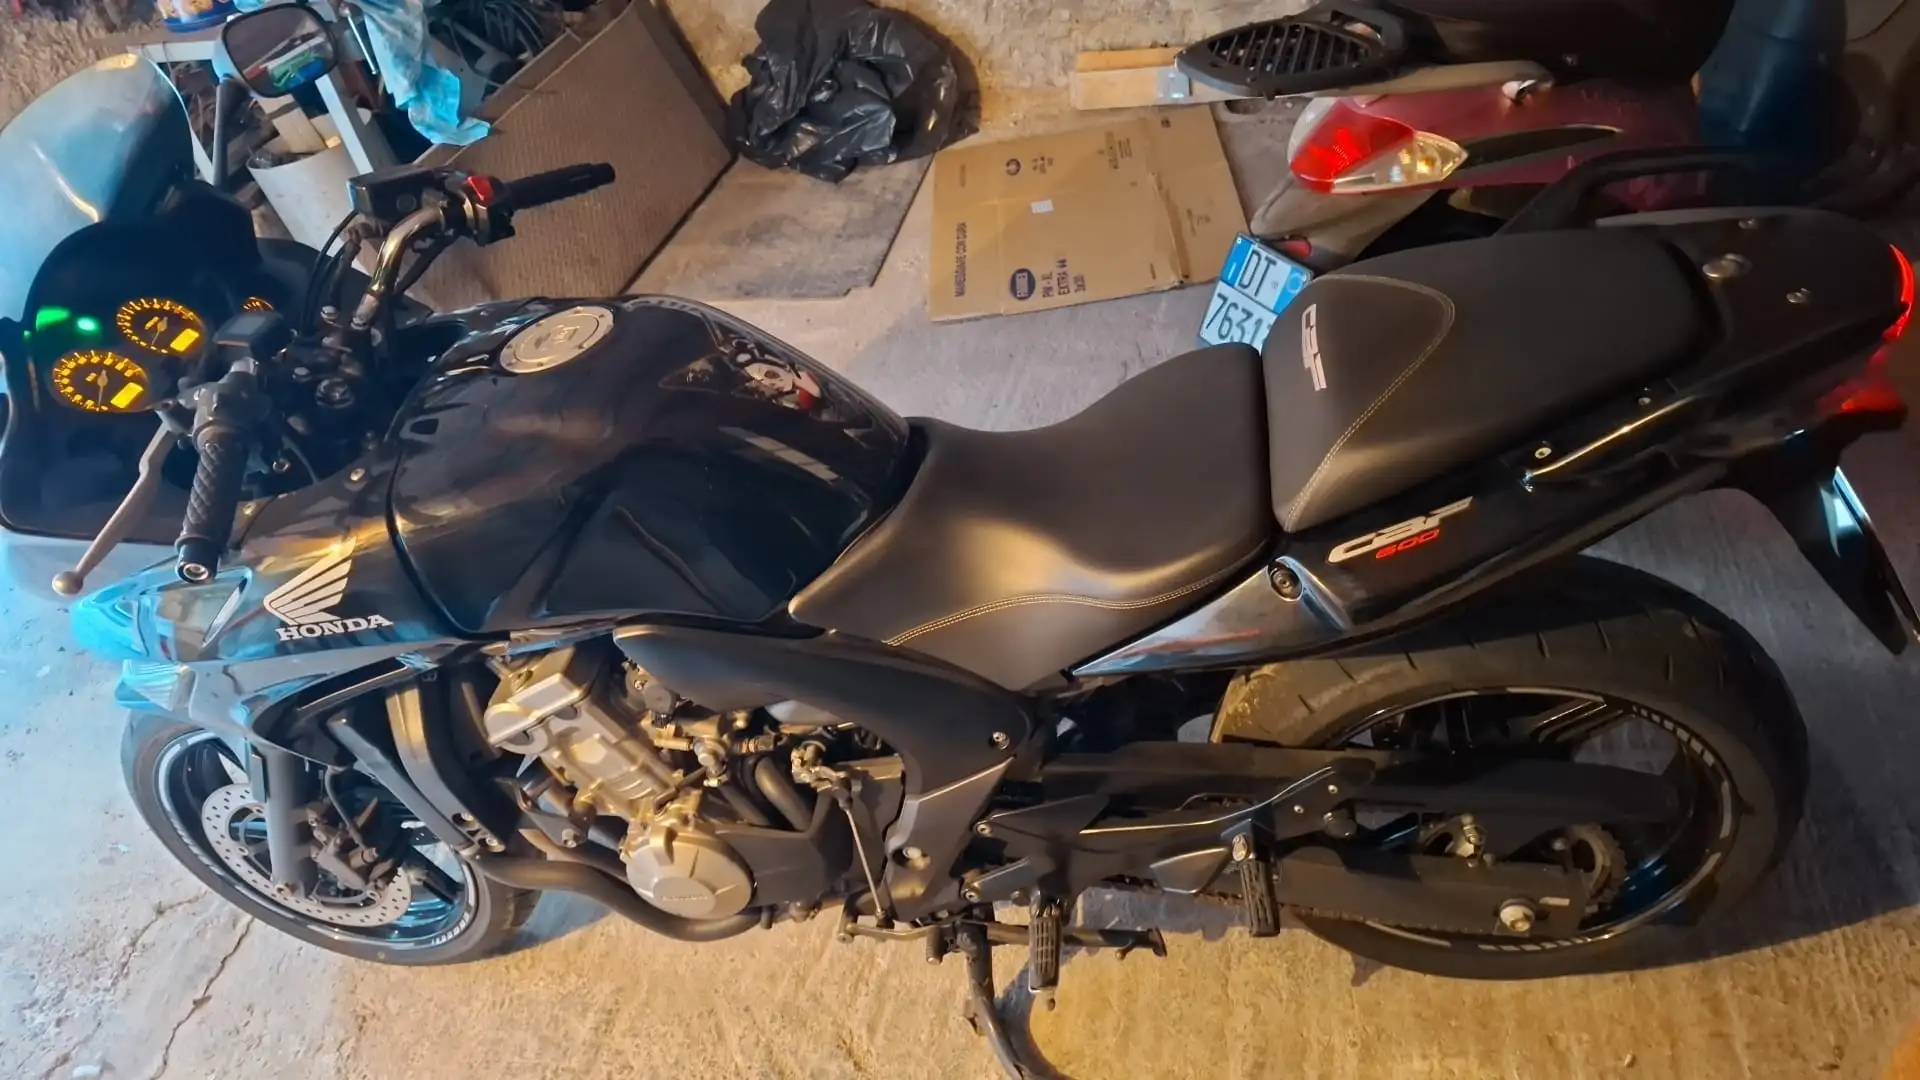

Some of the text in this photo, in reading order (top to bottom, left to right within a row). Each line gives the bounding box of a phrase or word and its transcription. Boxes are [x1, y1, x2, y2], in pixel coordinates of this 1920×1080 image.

[1239, 249, 1277, 296] DT
[1206, 292, 1272, 344] 7631
[1326, 495, 1473, 563] CBF
[1375, 528, 1440, 559] 600
[275, 614, 394, 641] HONDA
